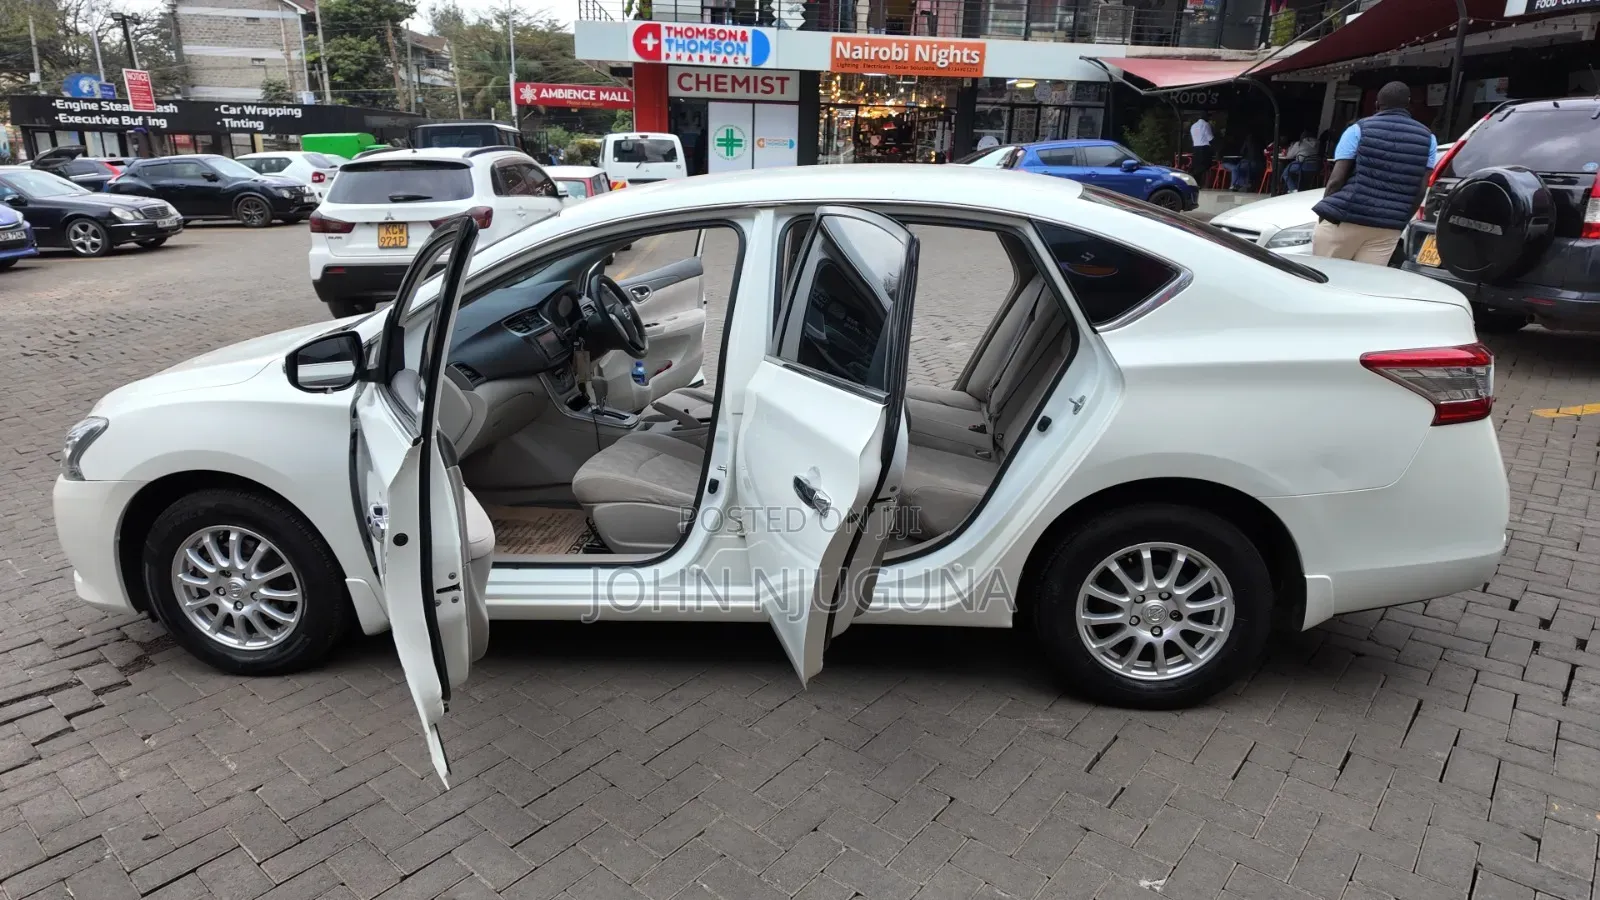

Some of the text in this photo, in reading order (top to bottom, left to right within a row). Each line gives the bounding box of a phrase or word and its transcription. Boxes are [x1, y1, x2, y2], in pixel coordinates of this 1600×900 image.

[1535, 0, 1558, 10] FOOD
[665, 38, 747, 56] THOMSON
[665, 53, 750, 65] PHARMACY
[836, 41, 980, 68] Nairobi Nights
[836, 62, 859, 71] Lighting
[863, 63, 891, 71] Electricals
[911, 64, 936, 72] Solutions
[126, 72, 149, 82] NOTICE
[677, 72, 790, 95] CHEMIST
[540, 88, 630, 102] AMBIENCE MALL
[1170, 88, 1219, 104] Roro's
[56, 100, 179, 113] Engine Stea ash
[220, 104, 302, 118] Car Wrapping
[58, 114, 119, 125] Executive
[222, 118, 264, 131] Tinting
[385, 224, 405, 235] KCW
[380, 236, 405, 247] 971P
